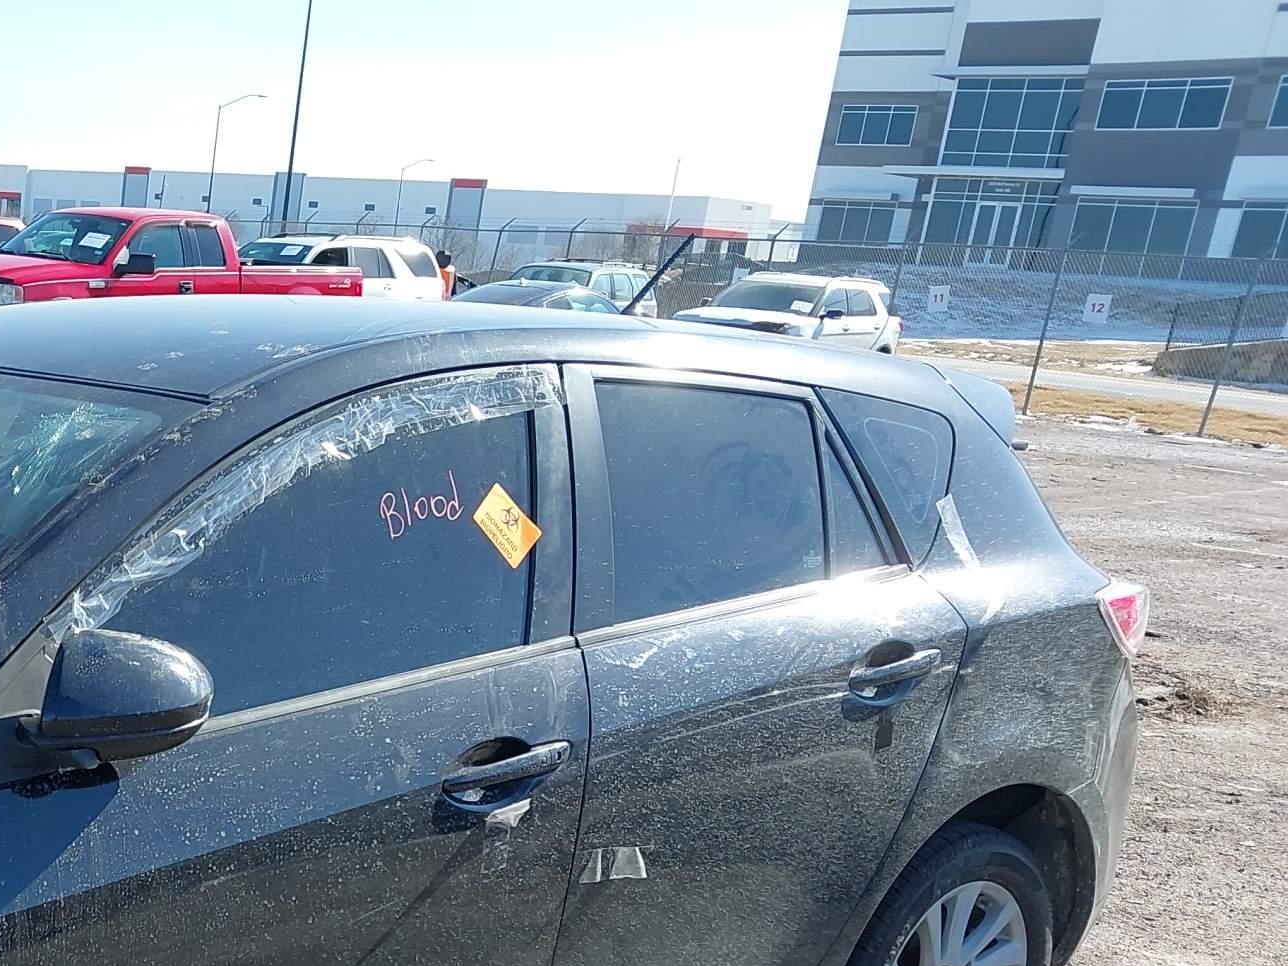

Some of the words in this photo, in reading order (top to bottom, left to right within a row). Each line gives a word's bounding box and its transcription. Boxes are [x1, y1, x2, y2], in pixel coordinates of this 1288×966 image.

[934, 294, 944, 303] 11
[1091, 303, 1105, 313] 12
[380, 469, 464, 540] Blood
[485, 511, 518, 553] BIOHAZARD
